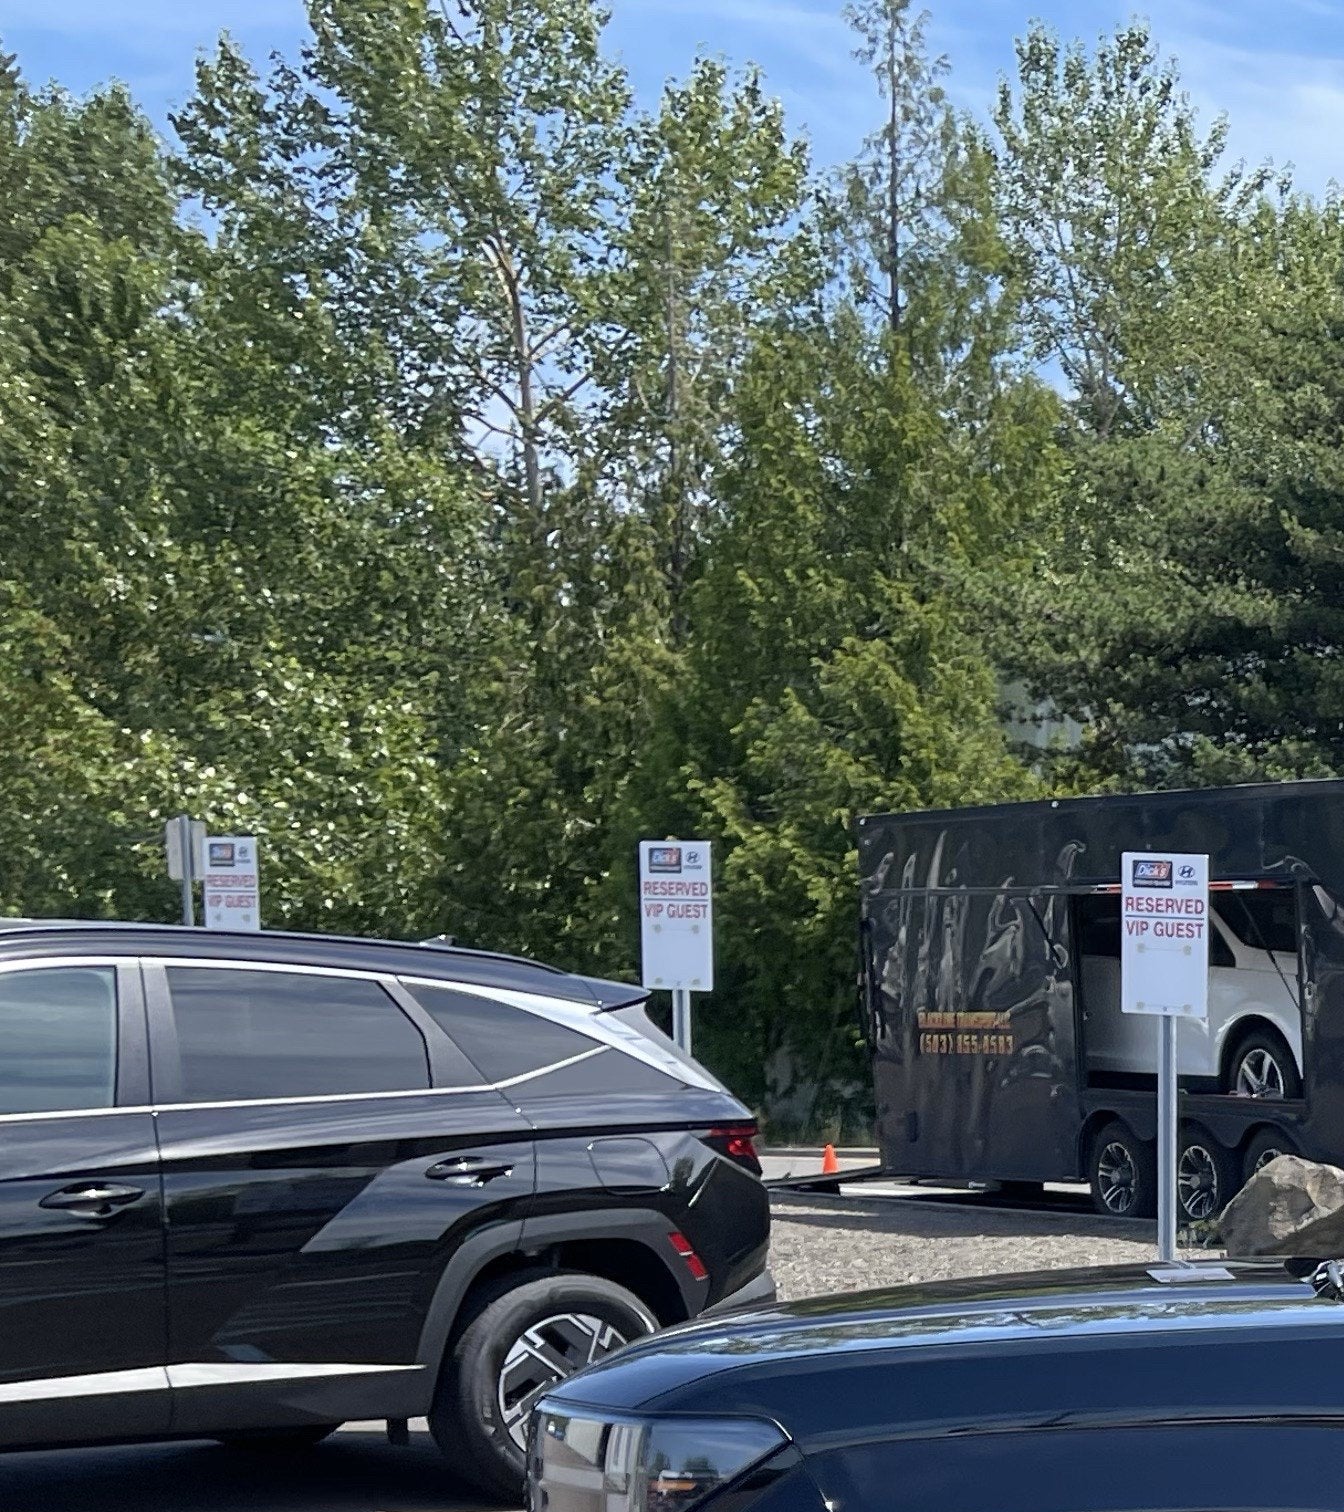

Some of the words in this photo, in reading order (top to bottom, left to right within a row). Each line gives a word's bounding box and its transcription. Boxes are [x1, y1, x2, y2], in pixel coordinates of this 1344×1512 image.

[643, 881, 709, 896] RESERVED
[645, 904, 664, 917] VIP
[667, 904, 708, 918] GUEST
[1125, 897, 1204, 914] RESERVED
[1126, 920, 1149, 936] VIP
[1153, 921, 1204, 938] GUEST
